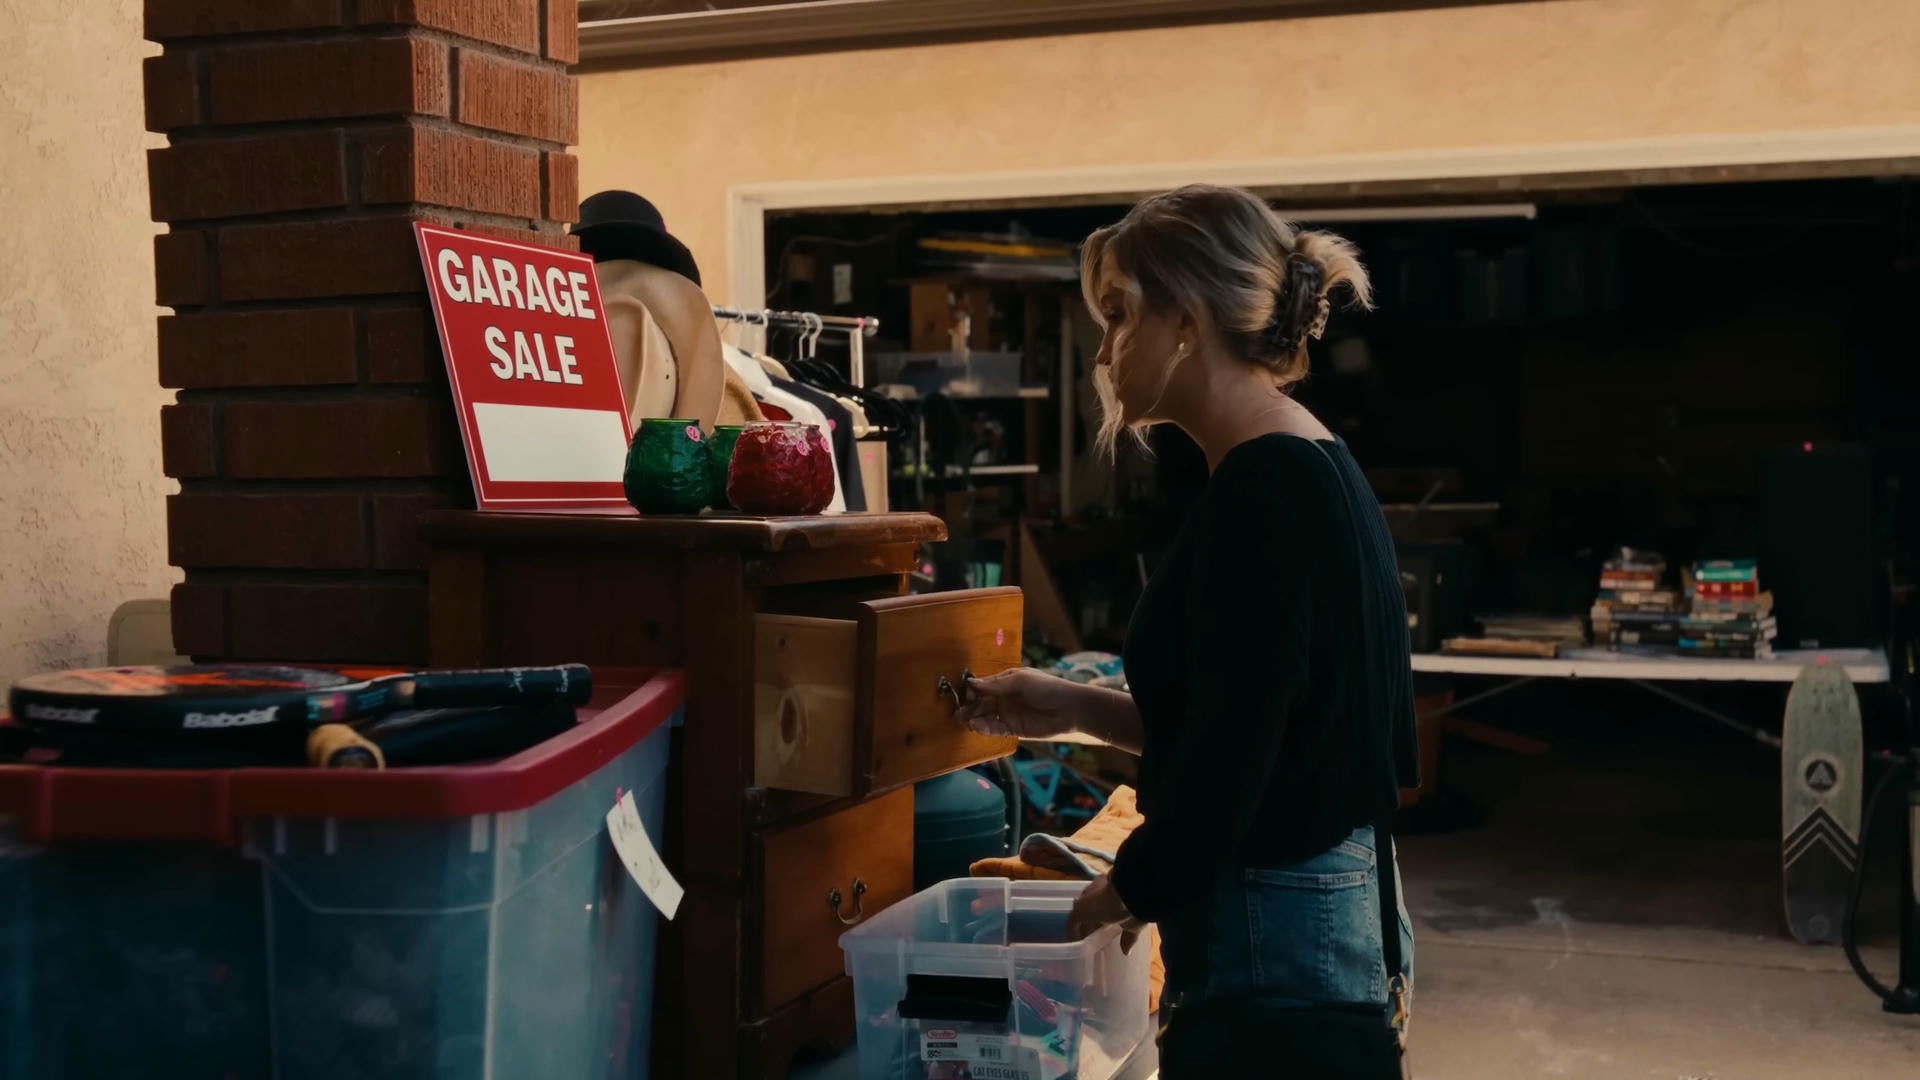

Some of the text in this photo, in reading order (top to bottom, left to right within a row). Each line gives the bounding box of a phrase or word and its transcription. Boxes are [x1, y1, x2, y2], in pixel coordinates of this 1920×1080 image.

[438, 248, 597, 320] GARAGE
[484, 325, 584, 386] SALE
[183, 706, 280, 728] Babolat
